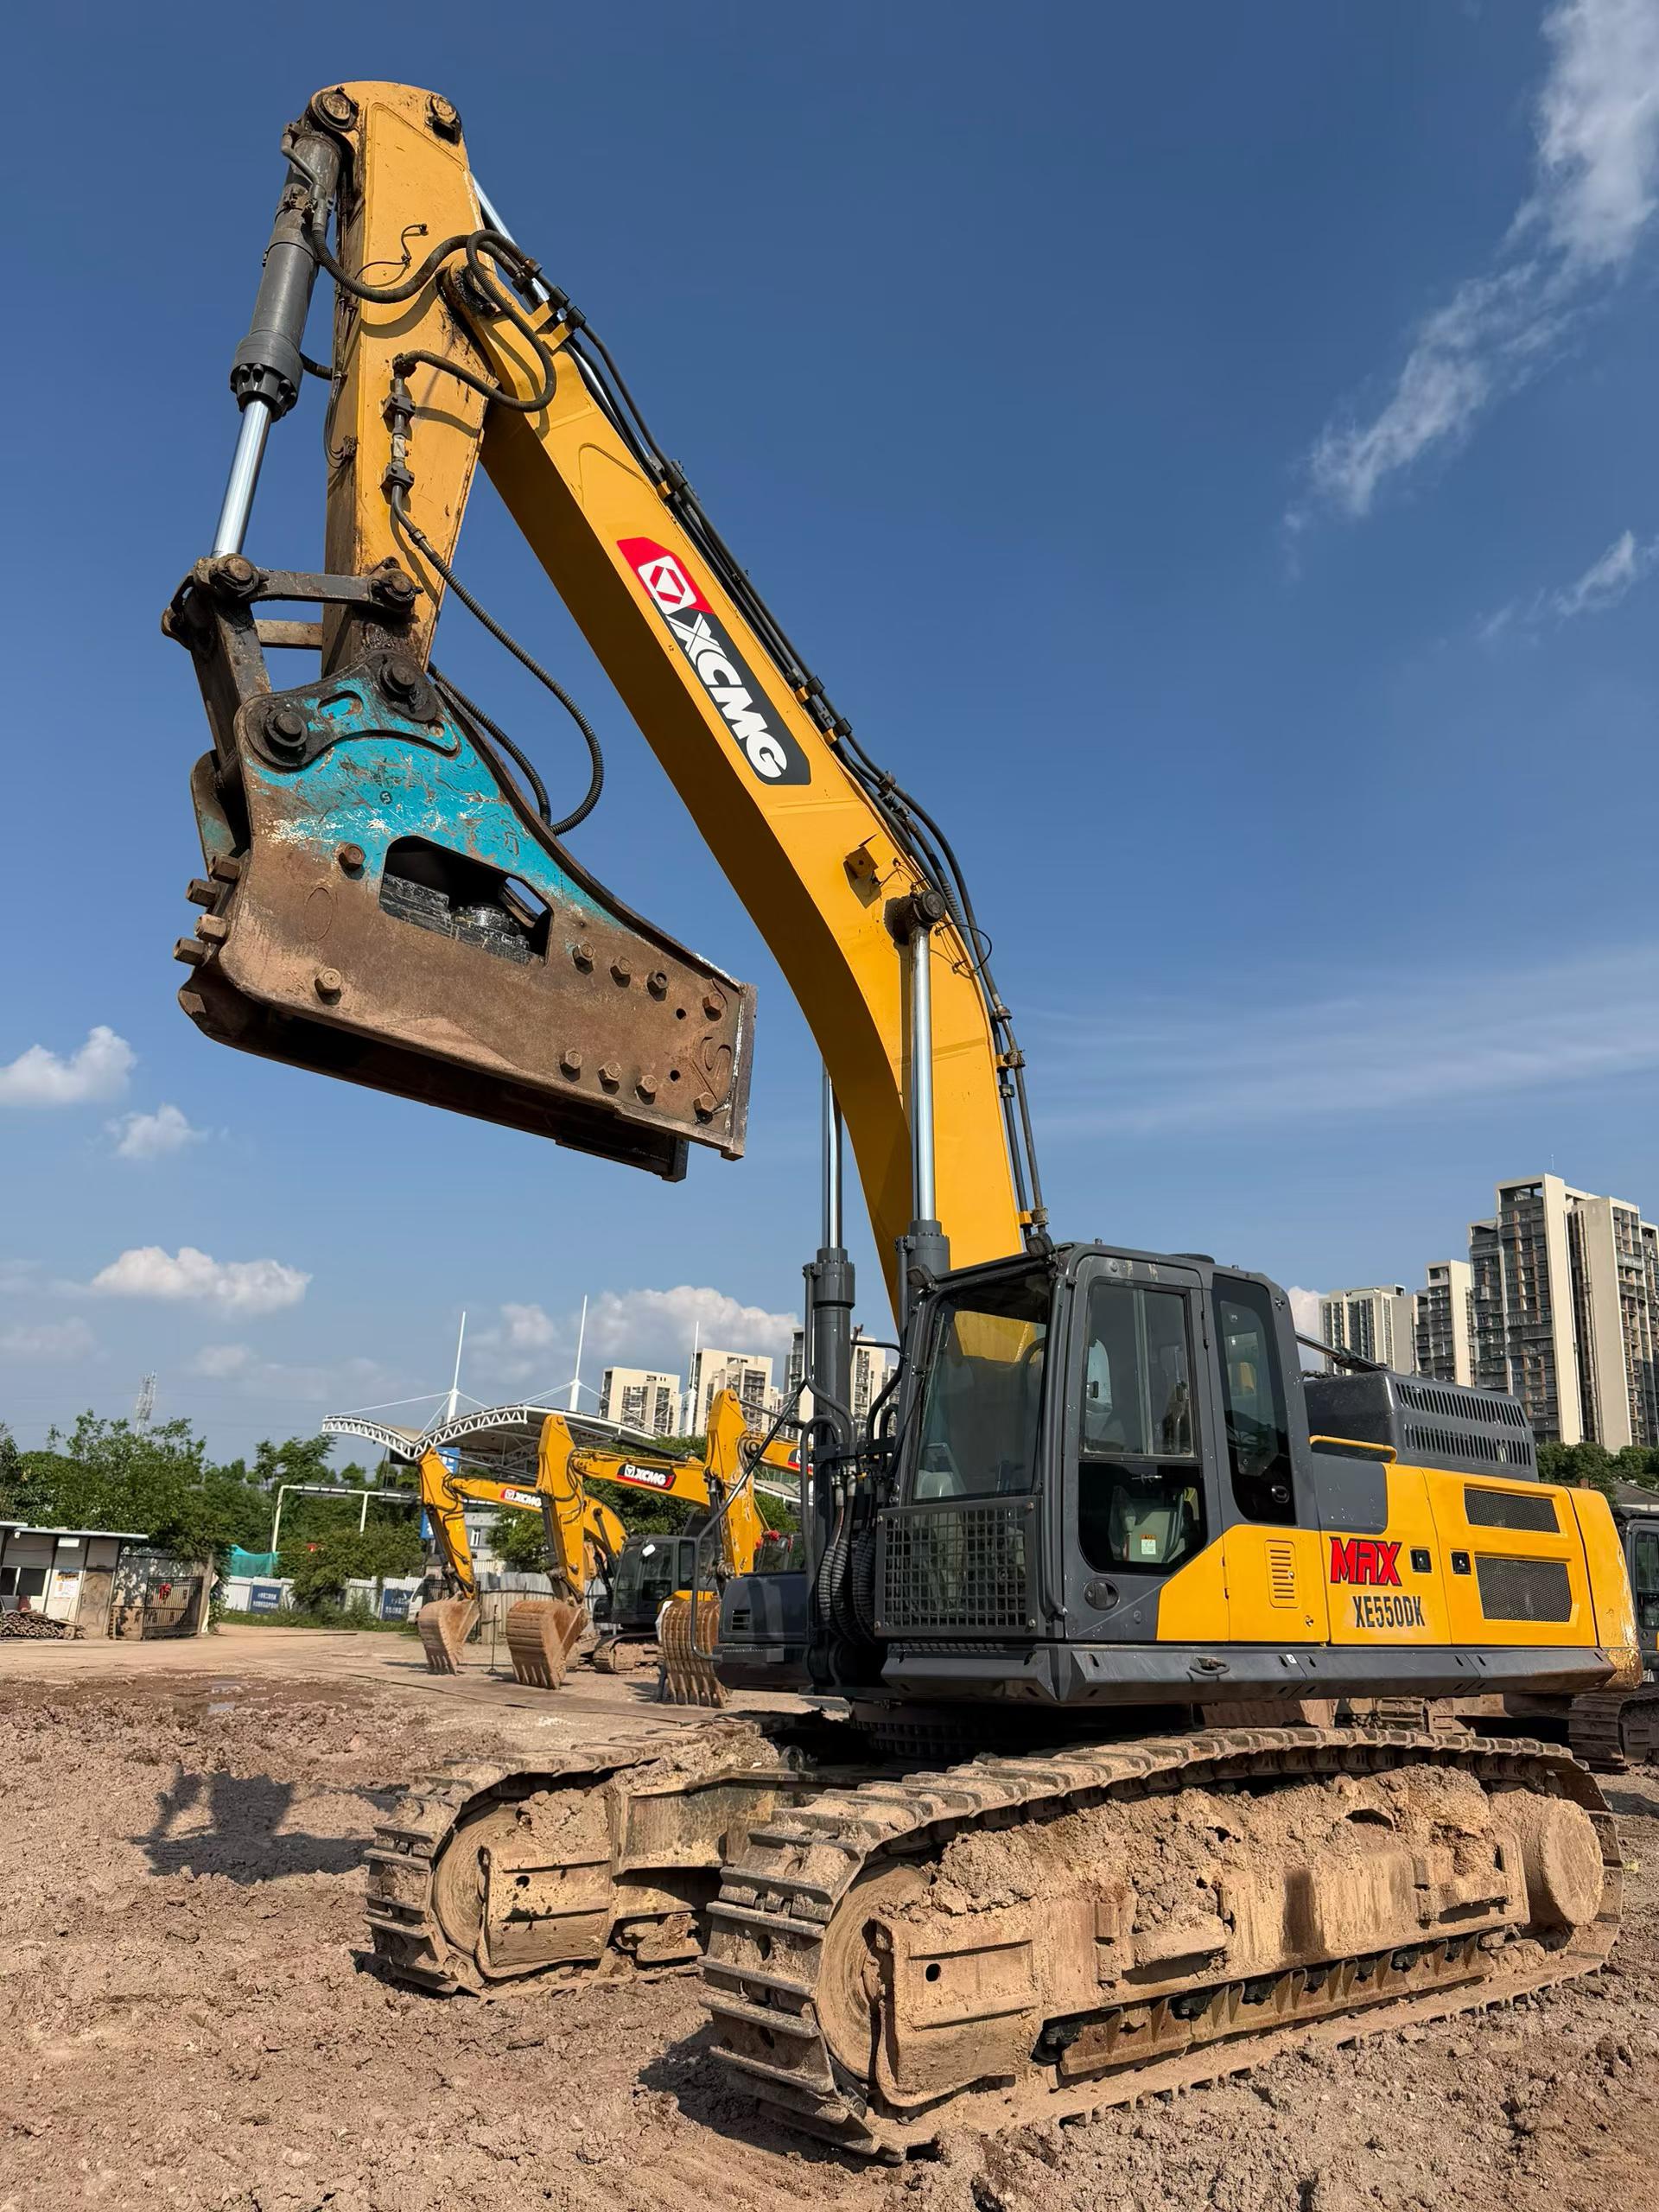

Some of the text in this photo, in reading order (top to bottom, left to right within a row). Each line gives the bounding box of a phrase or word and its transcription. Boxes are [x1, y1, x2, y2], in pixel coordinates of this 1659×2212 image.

[665, 612, 787, 779] XCMG
[635, 1467, 666, 1486] XCMG
[515, 1491, 543, 1508] XCMG
[1329, 1536, 1402, 1586] MAX
[1352, 1596, 1425, 1628] XE550DK
